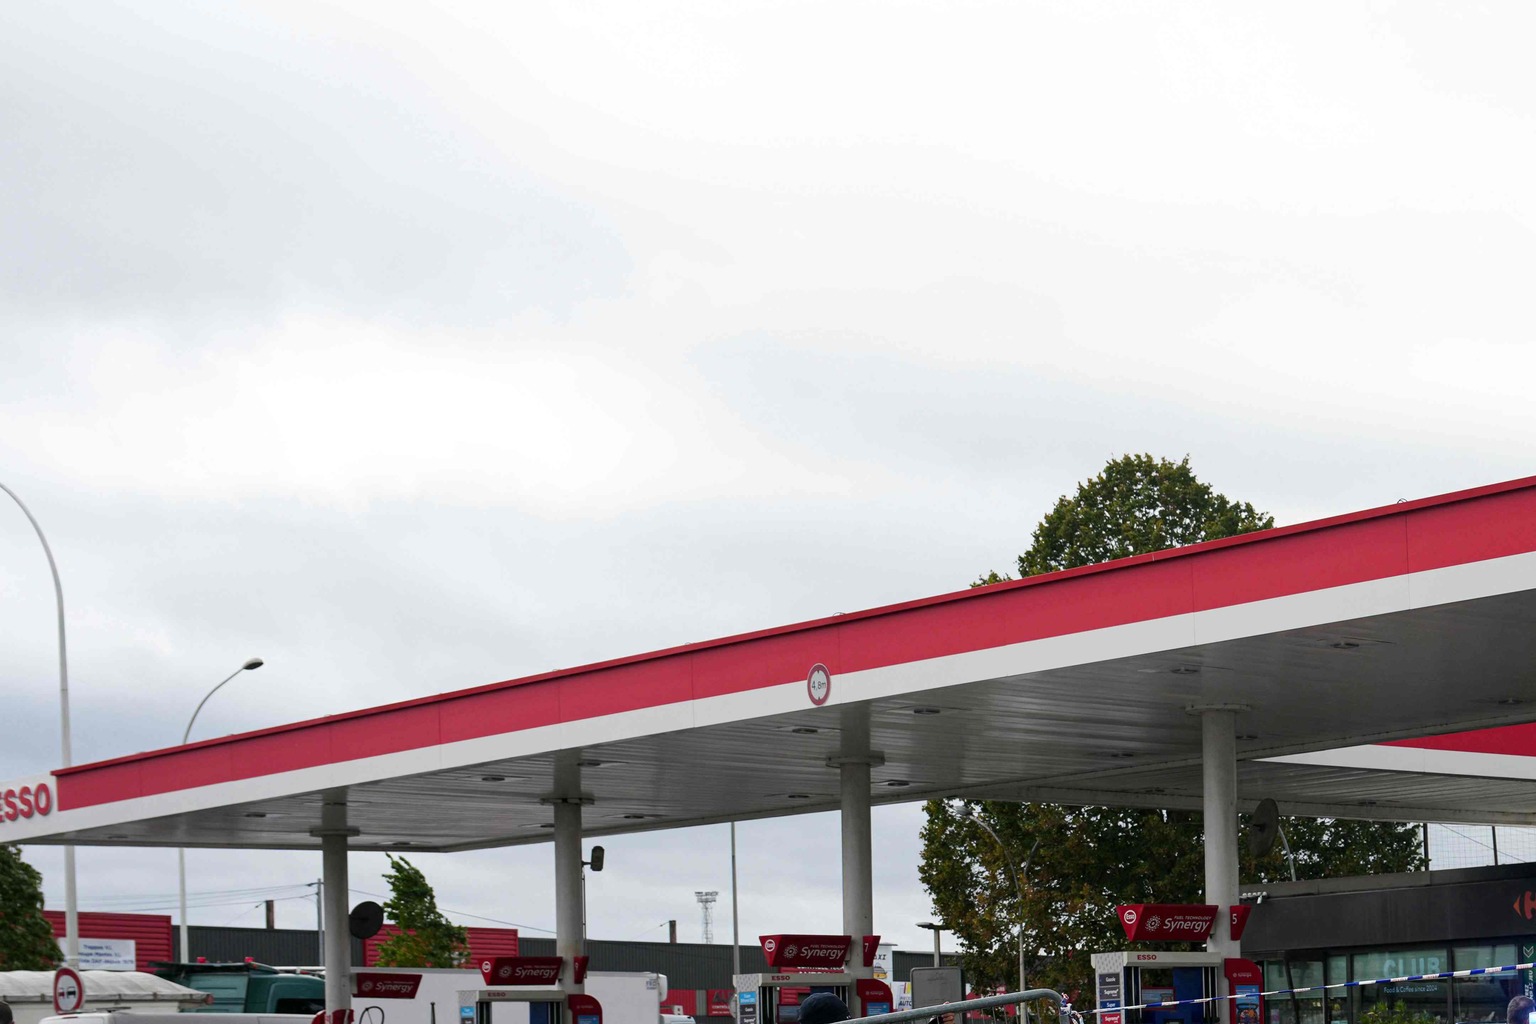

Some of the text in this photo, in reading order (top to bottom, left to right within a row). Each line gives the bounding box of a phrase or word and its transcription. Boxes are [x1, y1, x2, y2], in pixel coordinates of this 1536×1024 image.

[1162, 918, 1210, 933] Synergy
[1231, 914, 1238, 925] 5
[799, 946, 845, 960] Synergy
[864, 942, 869, 953] 7
[515, 966, 557, 979] Synergy
[1383, 957, 1441, 979] CLUB
[375, 981, 413, 993] Synergy
[1400, 985, 1414, 993] Coffee
[1426, 984, 1438, 992] 2004
